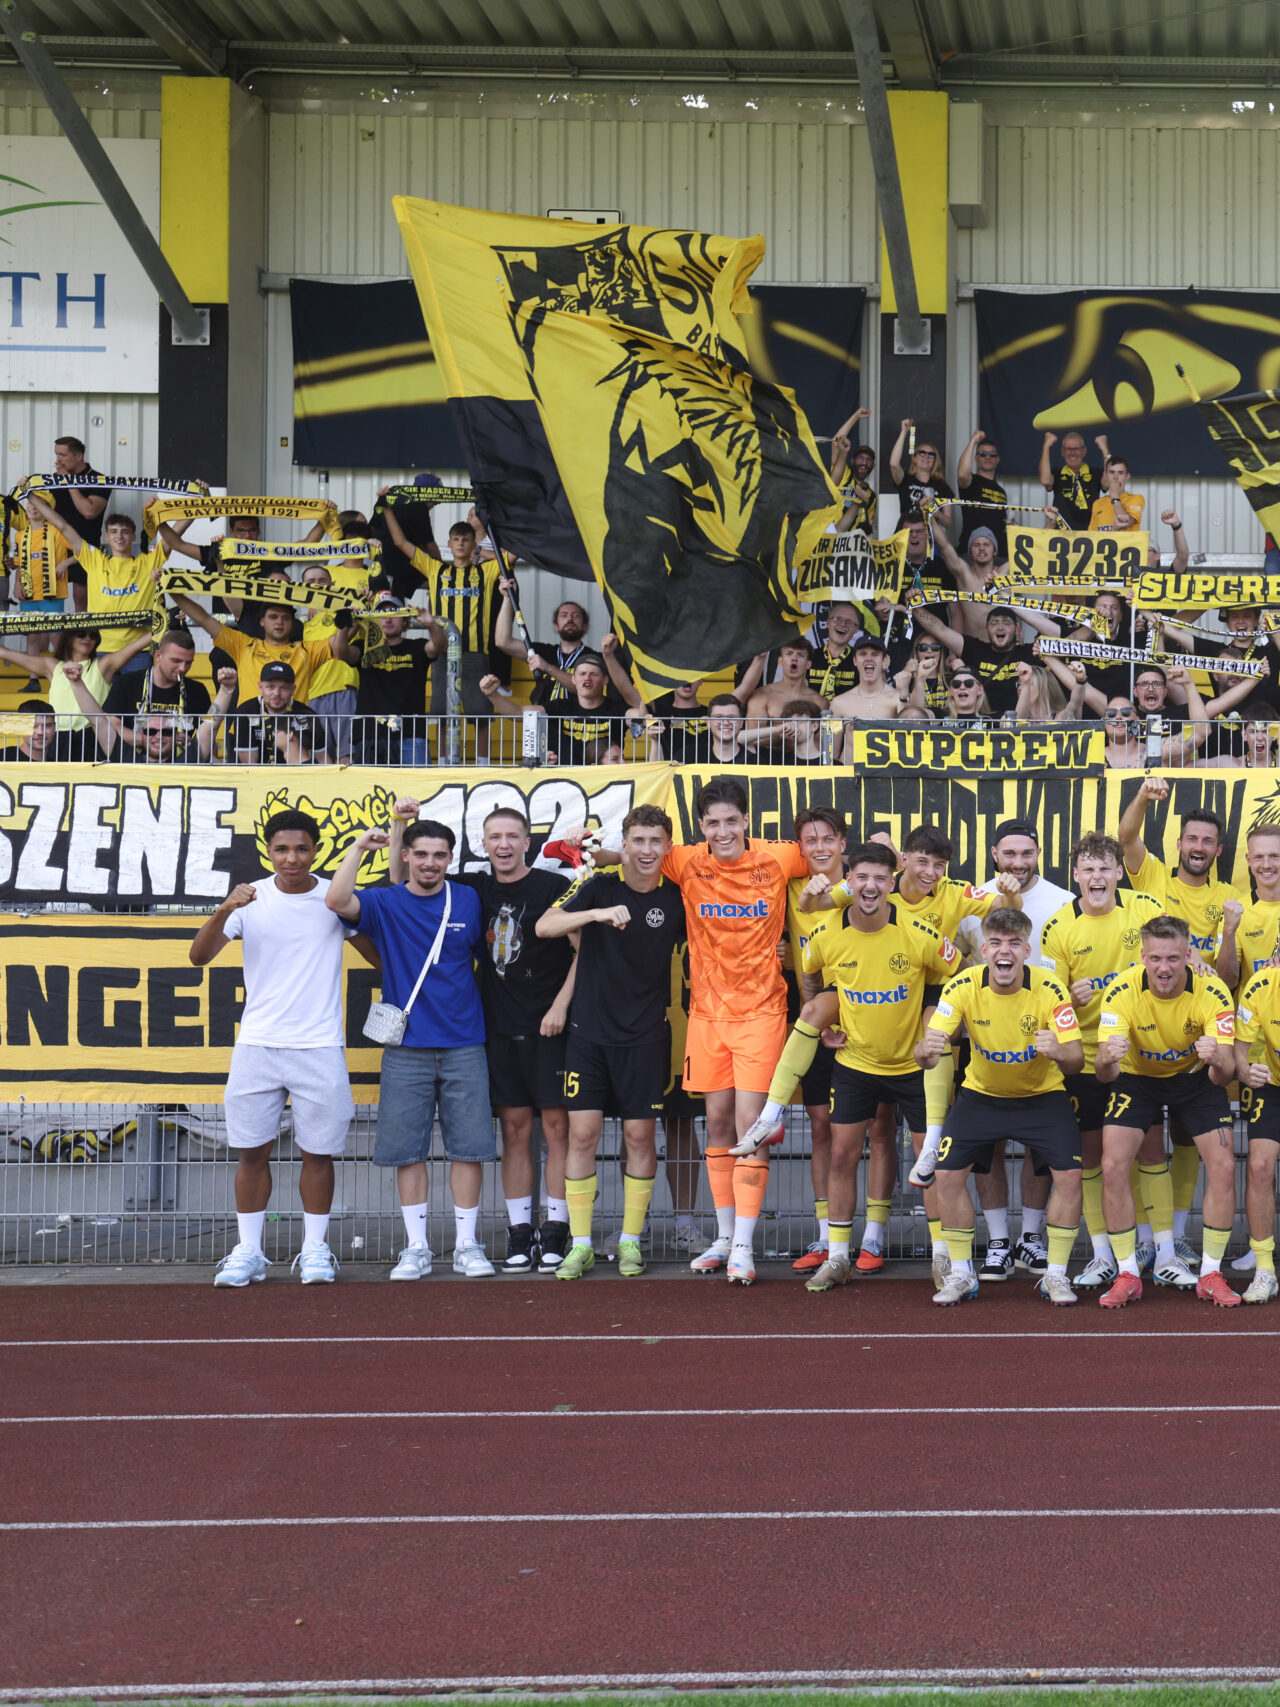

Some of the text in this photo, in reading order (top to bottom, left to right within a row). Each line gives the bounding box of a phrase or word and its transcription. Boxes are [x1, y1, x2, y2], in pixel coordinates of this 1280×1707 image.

[41, 474, 190, 492] SPVGG BAYREUTH
[164, 497, 319, 508] SPIELVEREINIGUNG
[184, 506, 300, 518] BAYREUTH 1921
[235, 542, 268, 556] Die
[1048, 536, 1141, 577] 323a
[101, 582, 139, 597] maxit
[866, 729, 1093, 768] SUPCREW
[700, 899, 769, 918] maxit
[1190, 932, 1214, 951] xit
[844, 984, 909, 1005] maxit
[0, 965, 246, 1048] NGER
[974, 1042, 1039, 1064] maxit
[1139, 1042, 1197, 1062] maxi
[685, 1056, 691, 1081] 1
